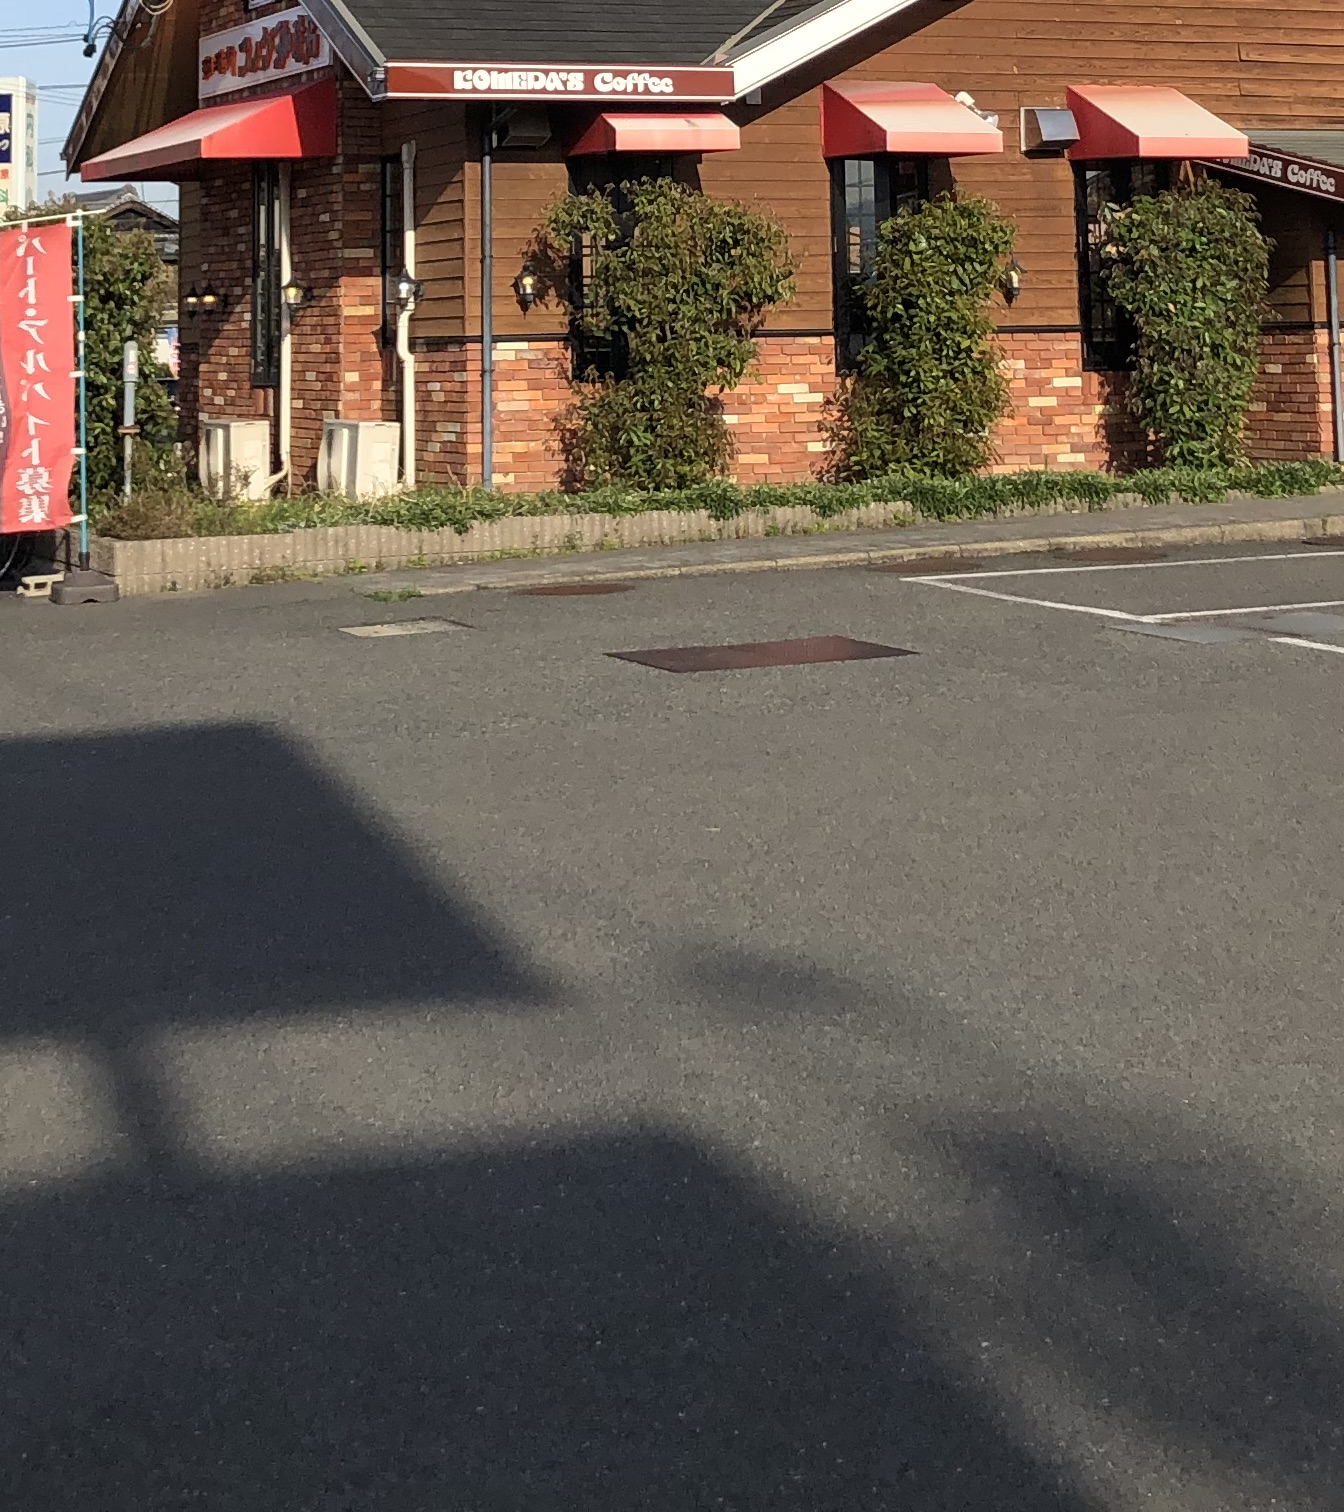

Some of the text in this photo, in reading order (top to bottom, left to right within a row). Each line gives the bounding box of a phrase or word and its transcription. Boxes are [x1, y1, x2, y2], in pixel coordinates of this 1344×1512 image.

[453, 68, 674, 93] KOMEDA'S Coffee
[1286, 163, 1336, 193] Coffee
